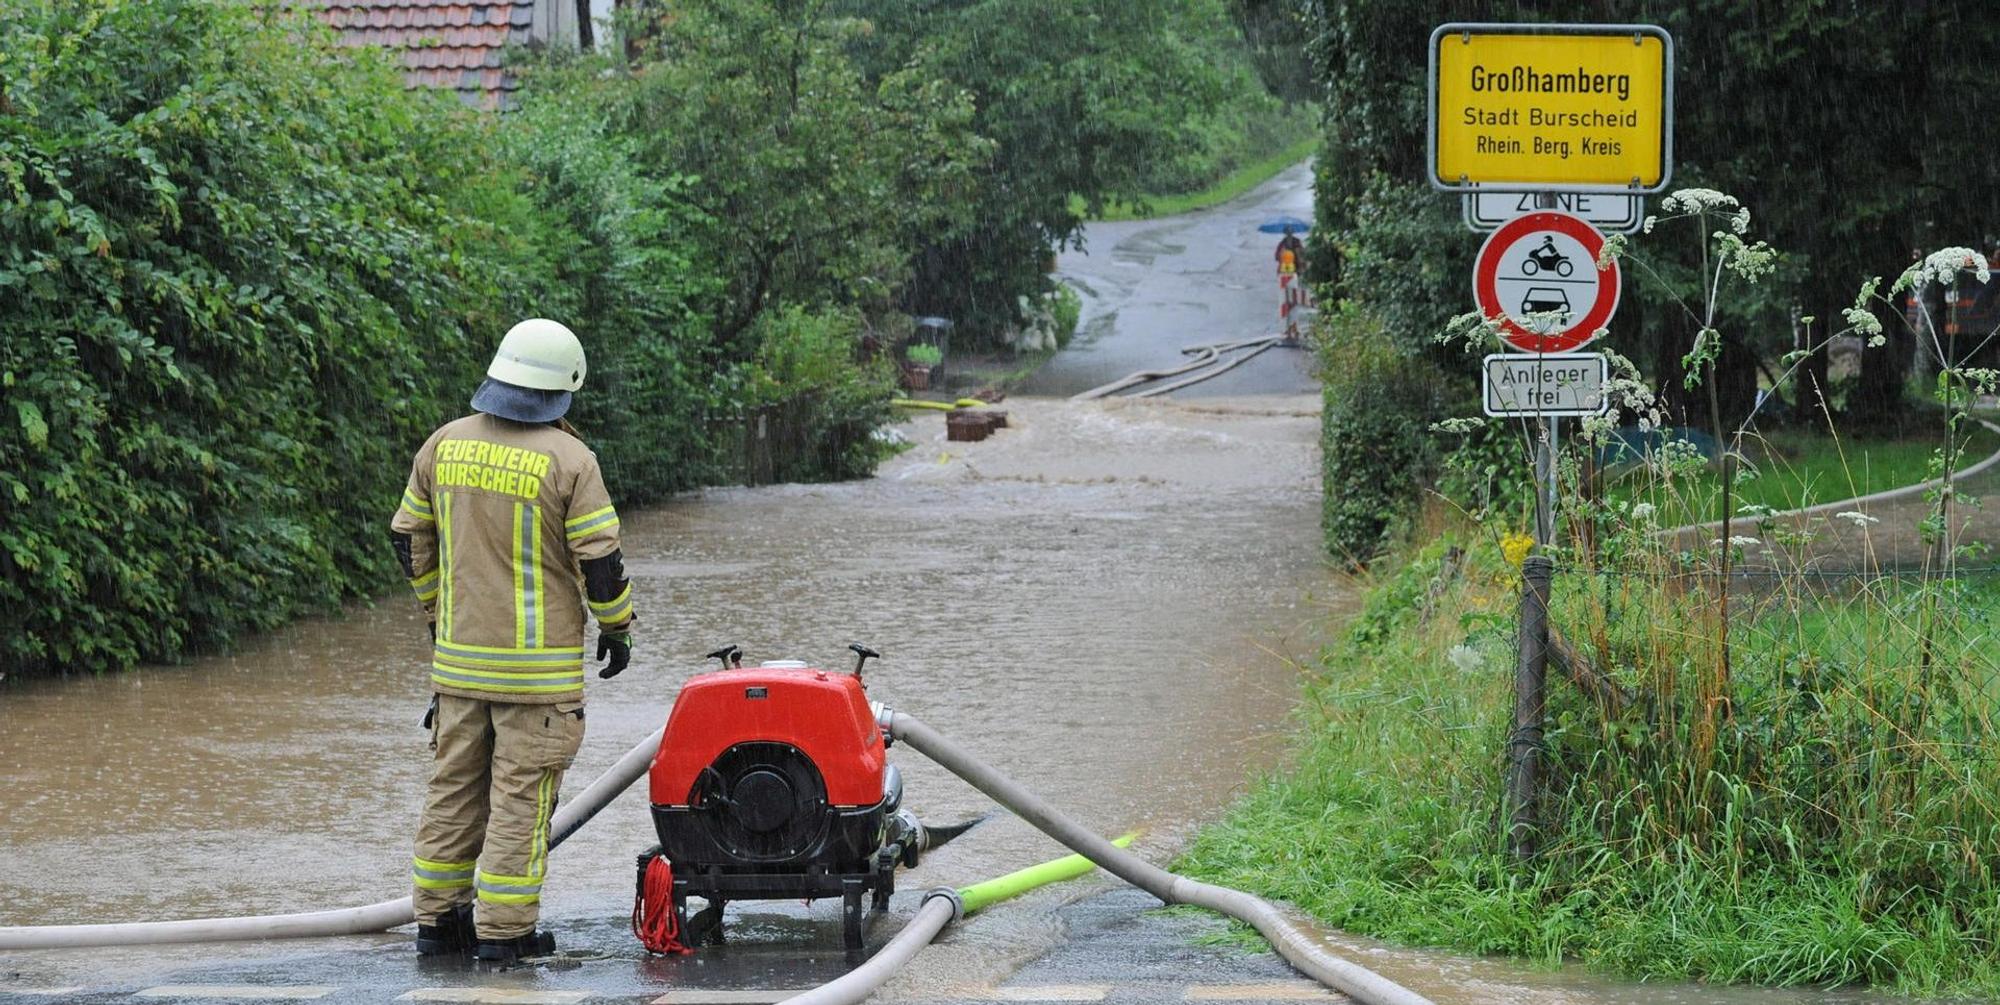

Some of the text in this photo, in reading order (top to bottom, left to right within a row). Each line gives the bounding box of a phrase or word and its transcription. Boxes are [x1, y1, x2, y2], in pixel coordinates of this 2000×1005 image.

[1471, 65, 1630, 101] Großhamberg
[1464, 107, 1637, 128] Stadt Burscheid
[1477, 136, 1622, 159] Rhein. Berg. Kreis
[1516, 192, 1592, 213] ZNE
[436, 439, 551, 478] FEUERWEHR
[436, 463, 541, 499] BURSCHEID
